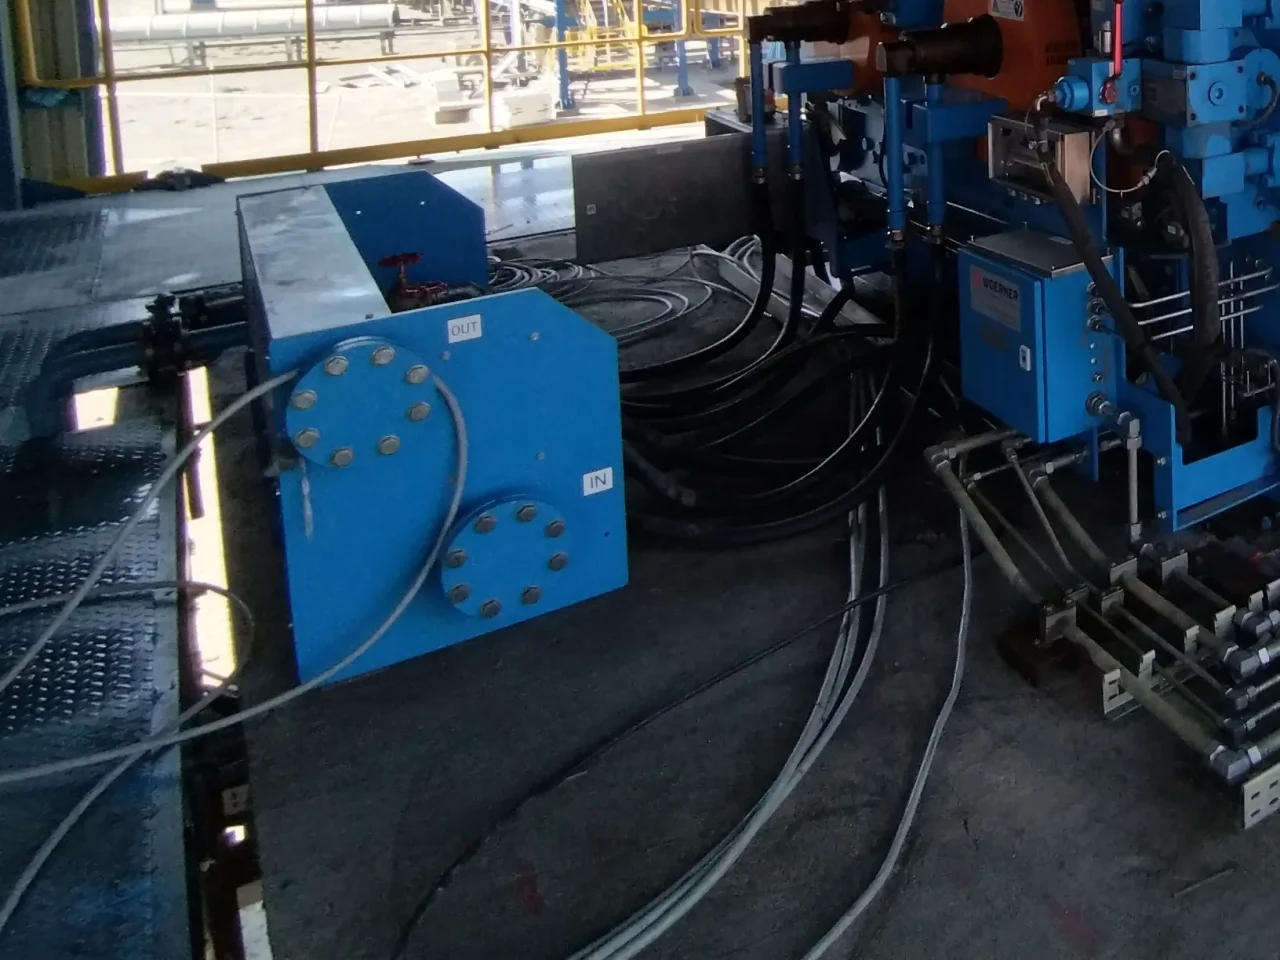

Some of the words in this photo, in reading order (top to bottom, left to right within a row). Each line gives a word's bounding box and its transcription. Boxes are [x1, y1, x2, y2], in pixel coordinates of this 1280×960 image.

[982, 276, 1019, 301] WOERNER
[451, 321, 477, 336] OUT
[590, 472, 606, 489] IN
